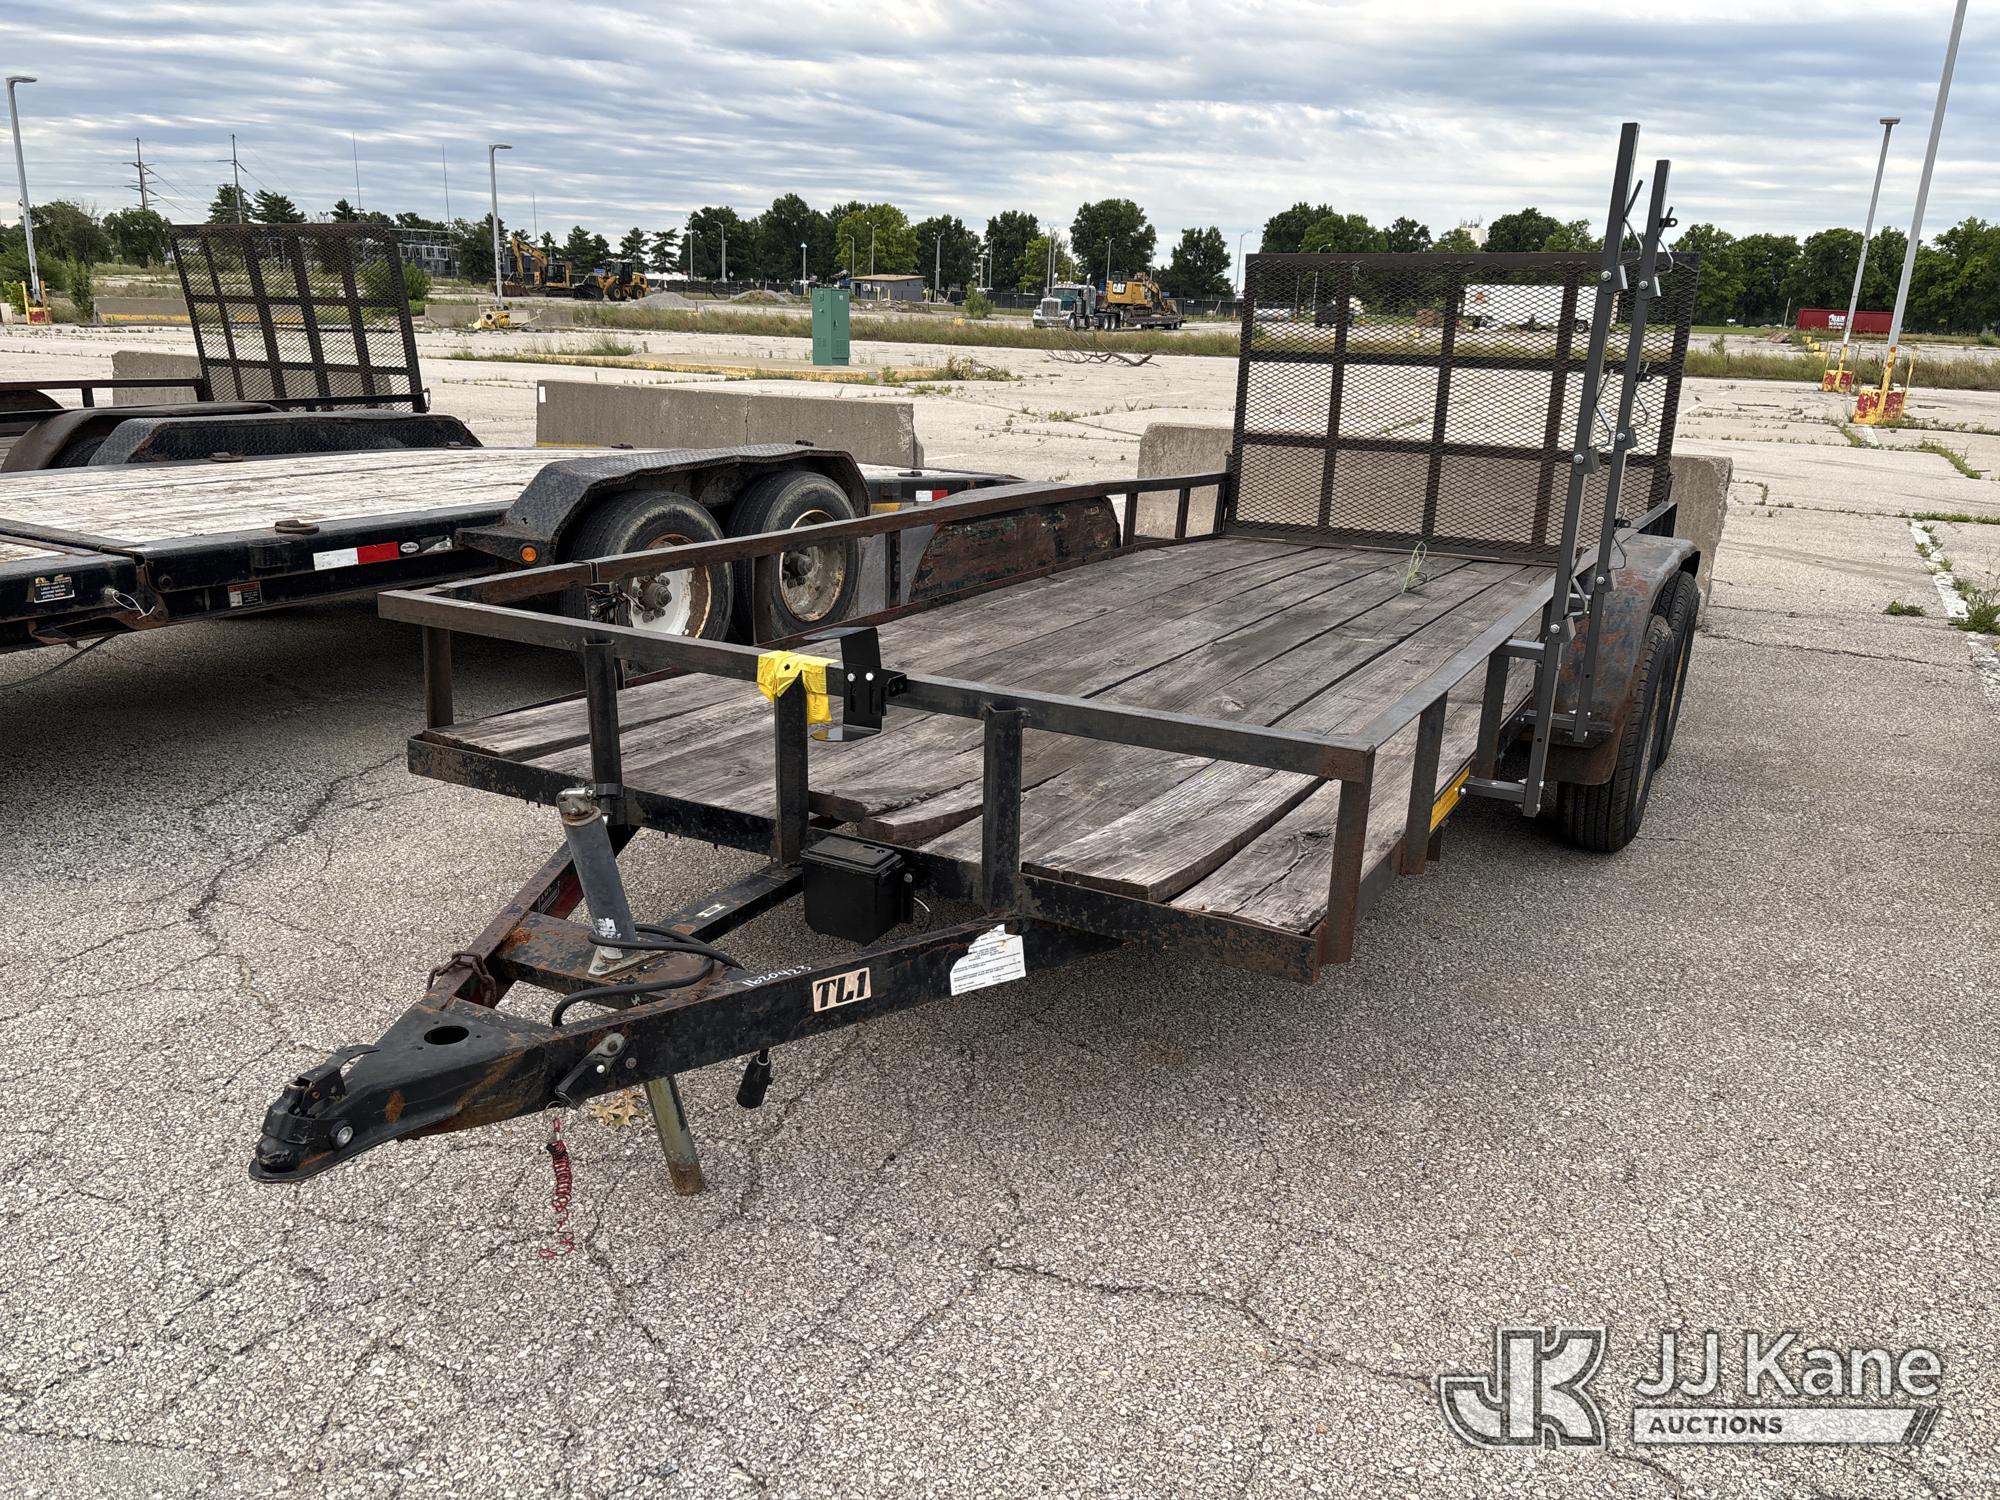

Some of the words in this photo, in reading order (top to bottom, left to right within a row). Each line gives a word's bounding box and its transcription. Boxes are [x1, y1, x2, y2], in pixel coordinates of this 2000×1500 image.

[1113, 283, 1125, 293] CAT
[742, 965, 812, 987] 1620423
[816, 971, 867, 1009] TL1
